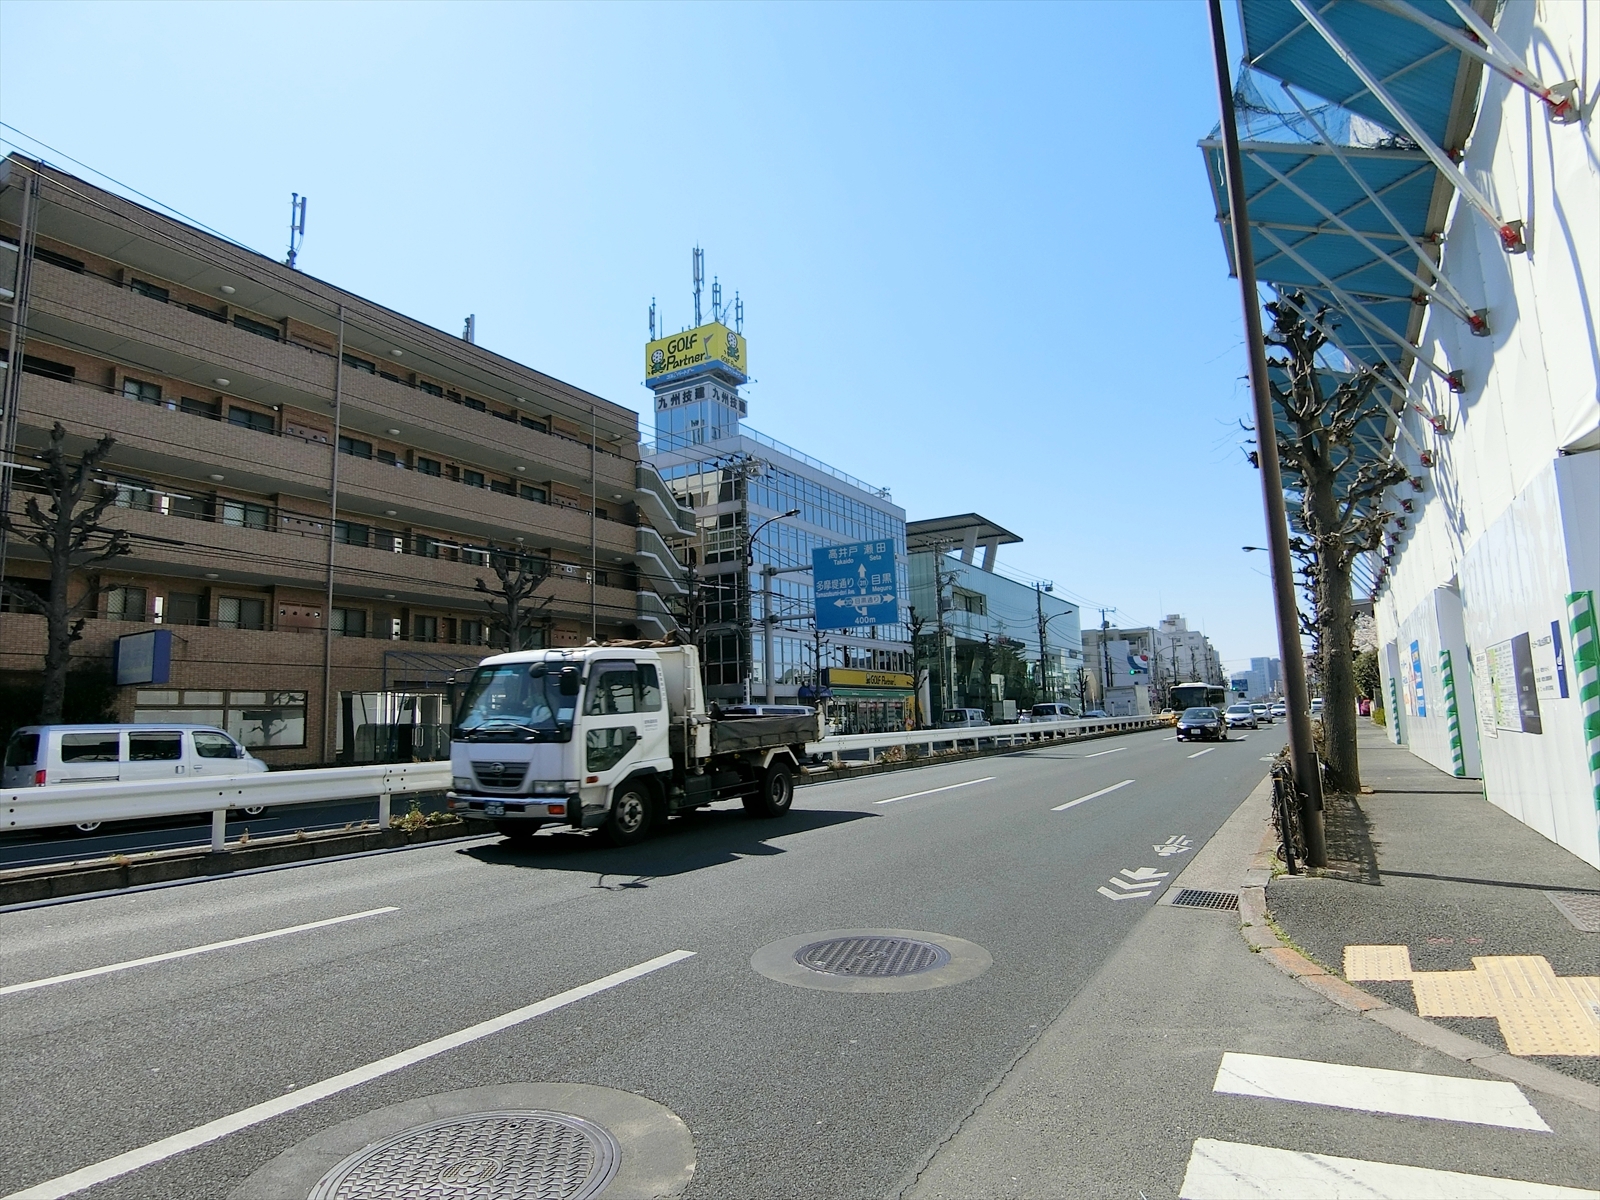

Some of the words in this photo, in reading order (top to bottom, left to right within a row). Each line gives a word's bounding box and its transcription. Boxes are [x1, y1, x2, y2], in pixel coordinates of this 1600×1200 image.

[668, 334, 697, 354] GOLF
[667, 352, 705, 371] Partner
[658, 386, 705, 409] 九州技建
[828, 545, 858, 560] 高井戸
[863, 542, 886, 554] 瀬田
[816, 577, 855, 591] 多摩堤通り
[871, 572, 892, 585] 目黒
[855, 616, 876, 624] 400m
[871, 675, 881, 684] GOLF
